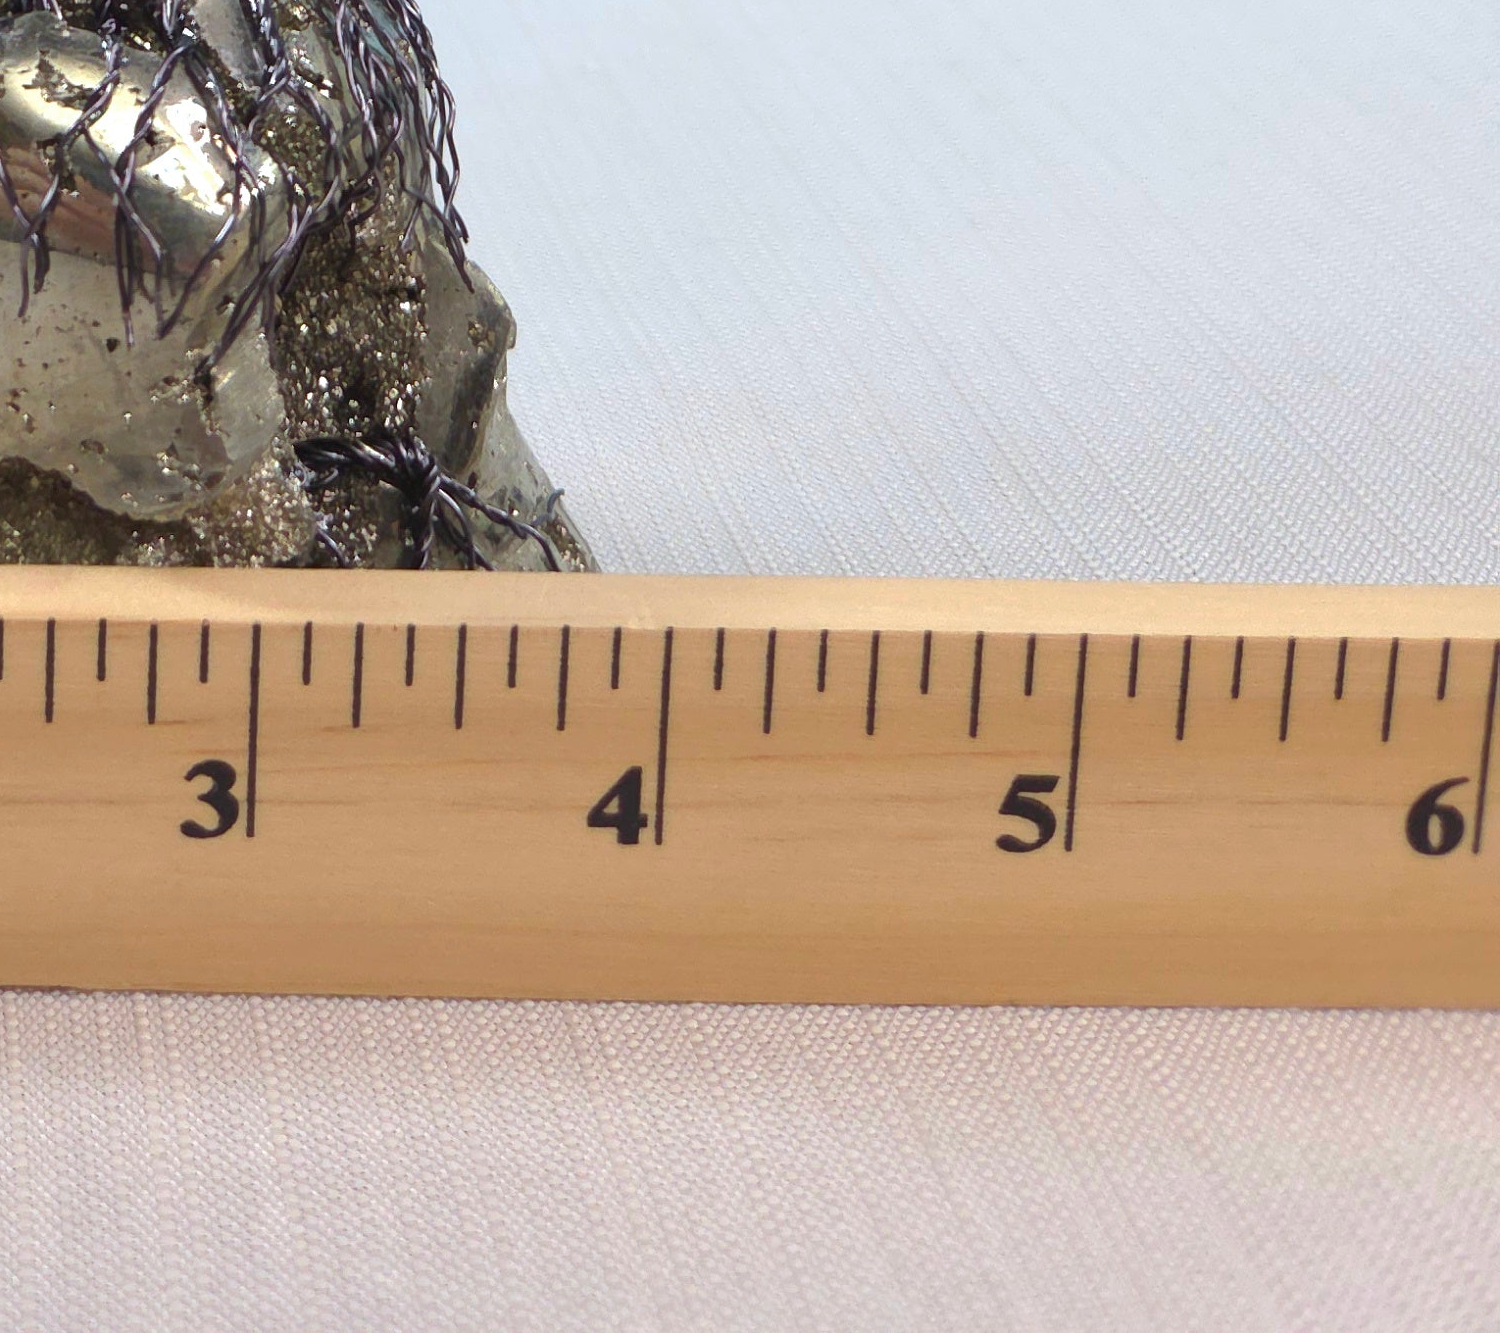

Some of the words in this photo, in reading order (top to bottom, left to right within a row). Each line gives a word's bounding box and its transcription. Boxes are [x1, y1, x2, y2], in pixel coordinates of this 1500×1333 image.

[180, 760, 240, 839] 3
[587, 766, 648, 845] 4
[996, 774, 1060, 853] 5
[1405, 776, 1470, 856] 6
